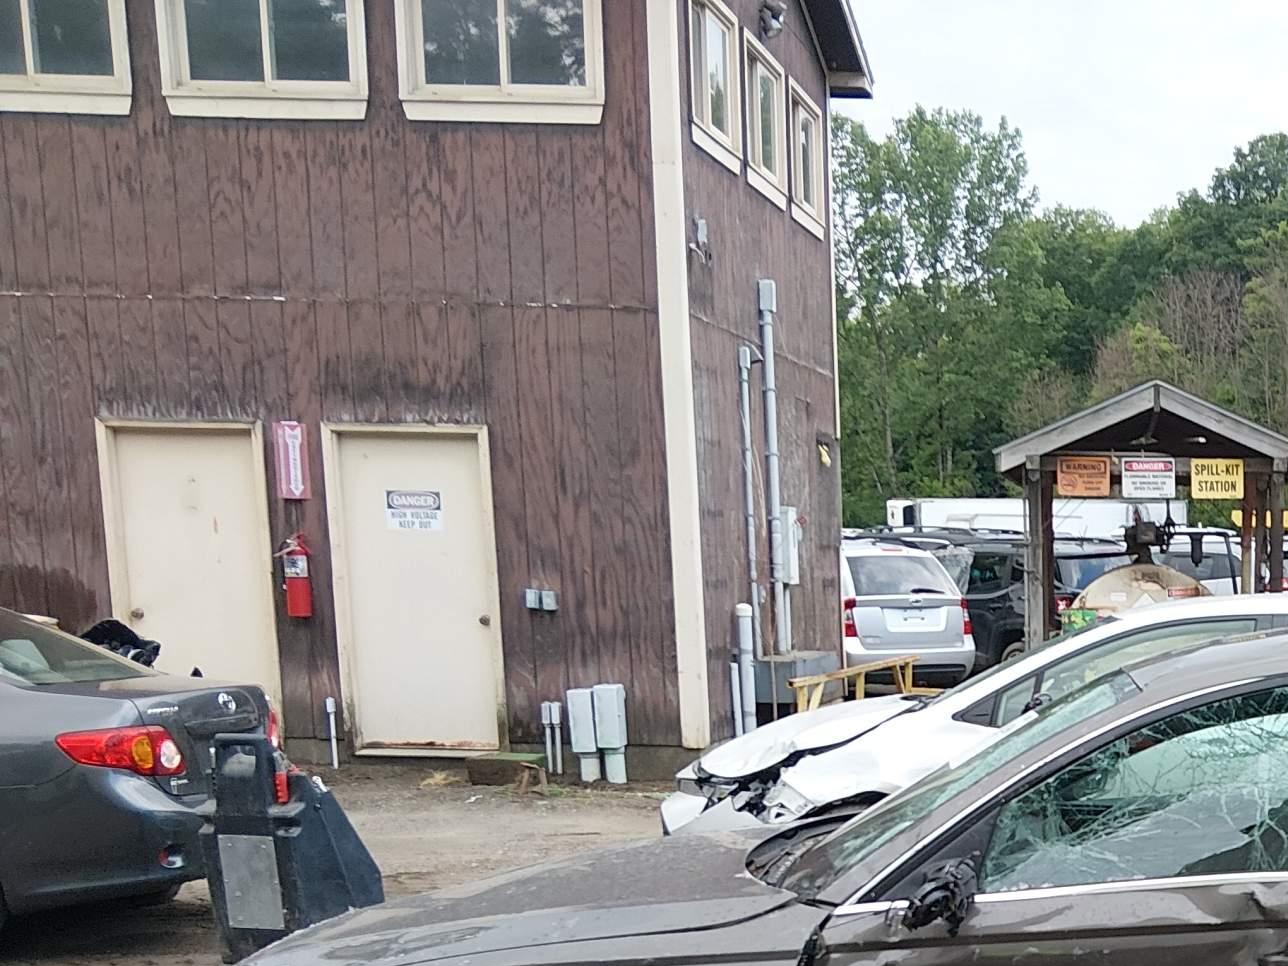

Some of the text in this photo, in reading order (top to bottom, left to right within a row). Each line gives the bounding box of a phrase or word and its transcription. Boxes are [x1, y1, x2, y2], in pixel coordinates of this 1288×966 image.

[1065, 463, 1102, 471] WARNING
[1132, 462, 1165, 471] DANGER
[1194, 463, 1241, 476] SPILL-KIT
[1198, 480, 1237, 492] STATION
[393, 495, 435, 506] DANGER
[410, 511, 438, 520] VOLTAGE
[398, 520, 432, 528] KEEP OUT
